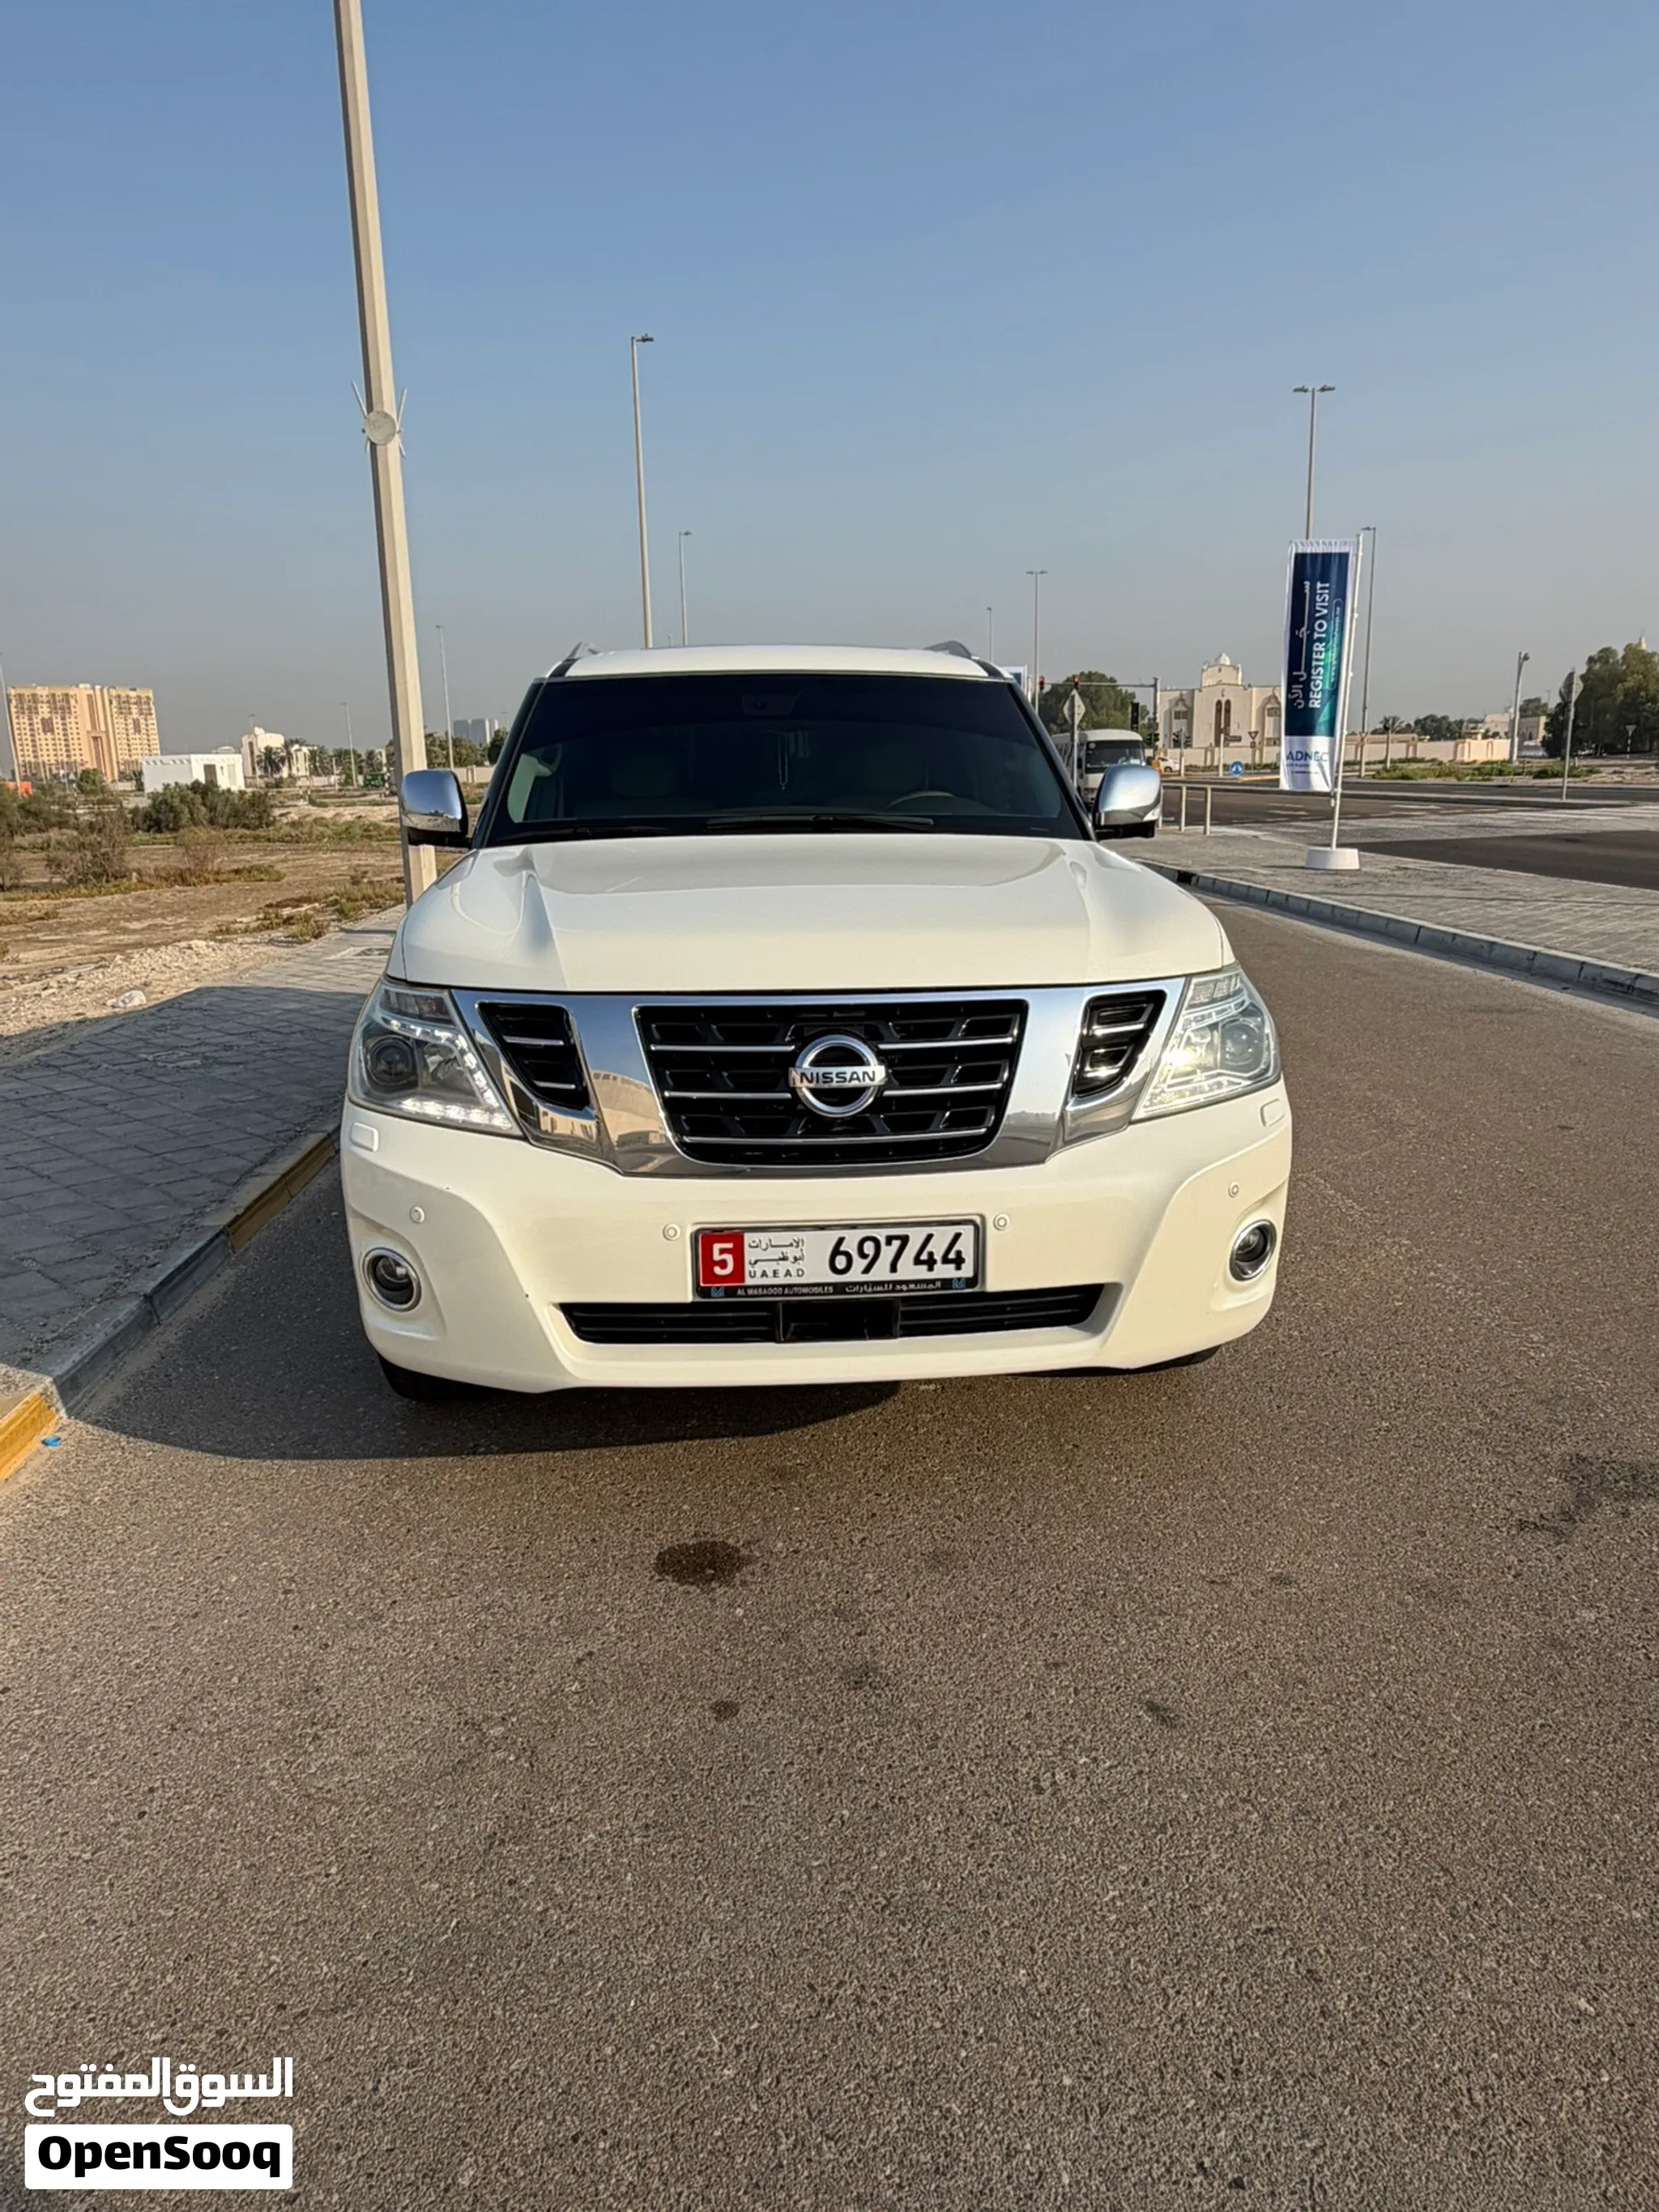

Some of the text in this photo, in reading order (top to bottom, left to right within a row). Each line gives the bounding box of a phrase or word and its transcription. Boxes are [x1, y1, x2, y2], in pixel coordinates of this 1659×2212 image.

[1309, 581, 1330, 709] REGISTER TO VISIT
[1286, 750, 1329, 762] ADNEC
[800, 1070, 876, 1085] NISSAN
[712, 1242, 734, 1276] 5
[828, 1231, 966, 1276] 69744
[736, 1287, 746, 1296] AL
[783, 1285, 834, 1295] AUTOMOBILES
[894, 1281, 942, 1291] المسعود
